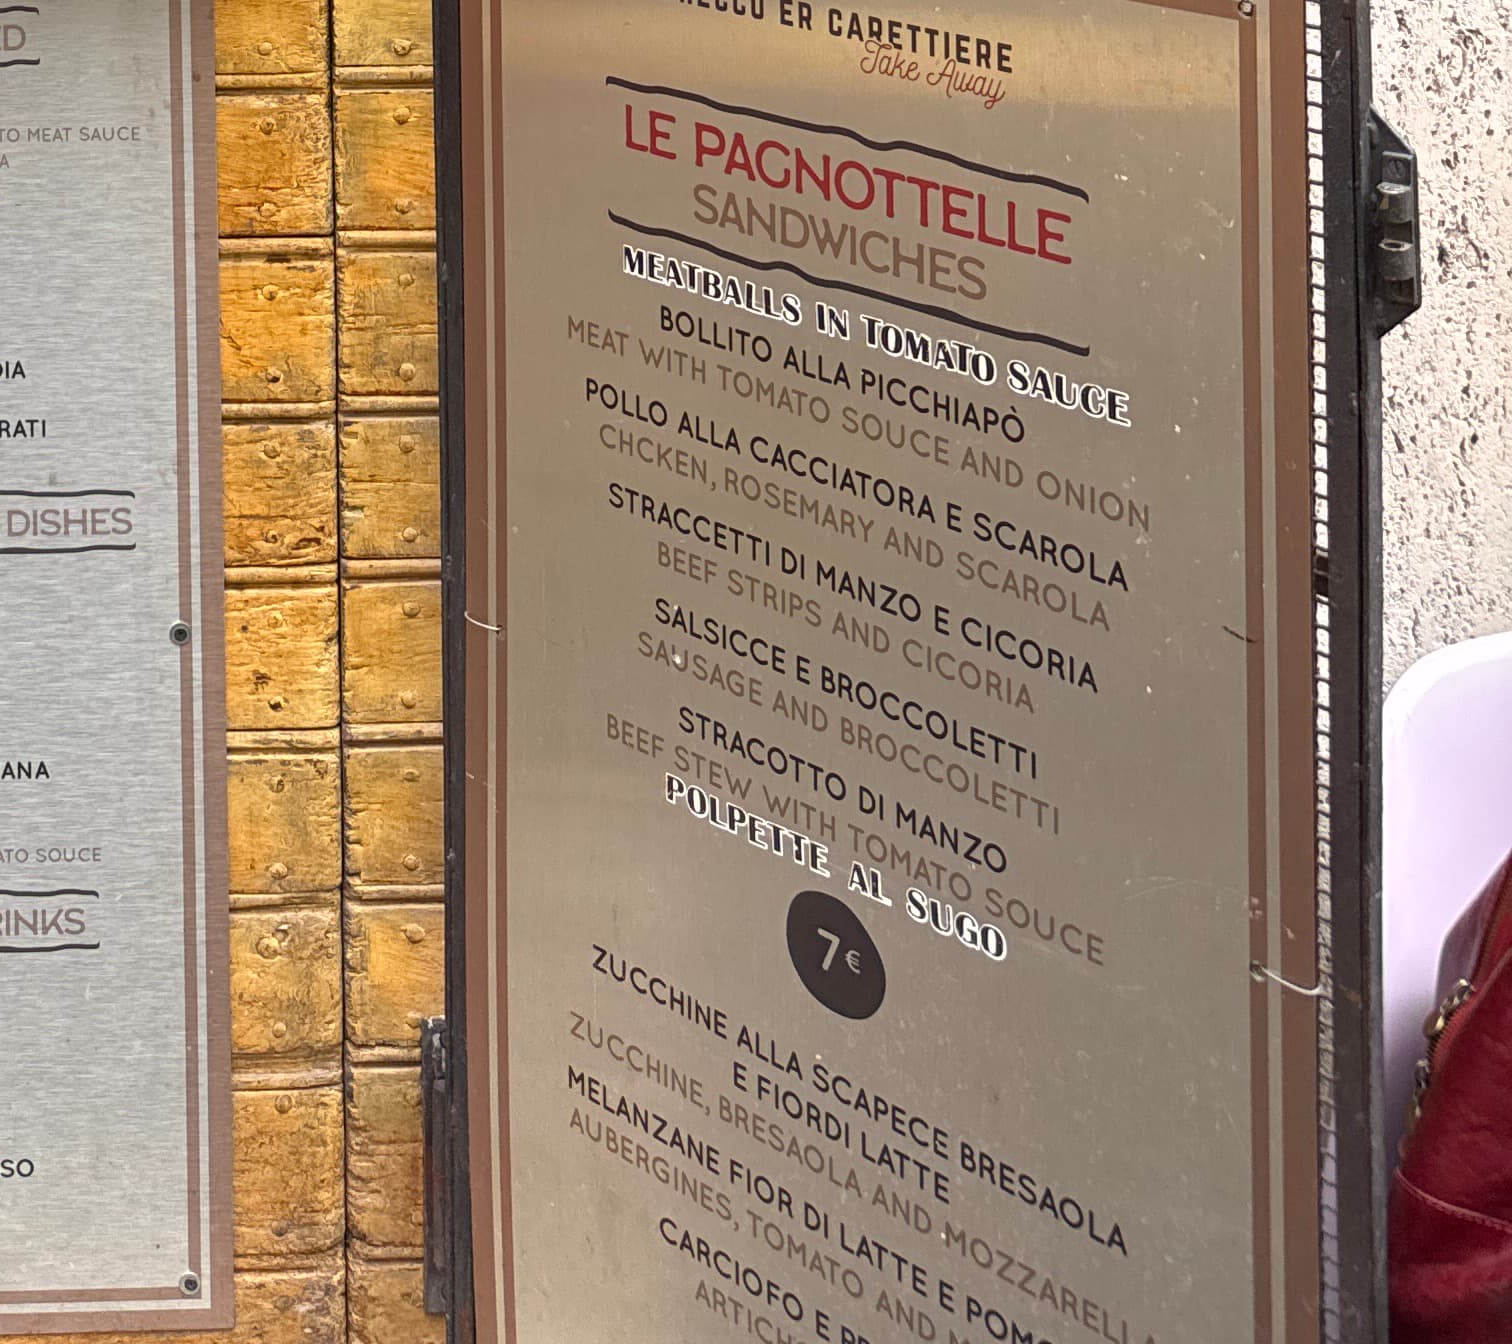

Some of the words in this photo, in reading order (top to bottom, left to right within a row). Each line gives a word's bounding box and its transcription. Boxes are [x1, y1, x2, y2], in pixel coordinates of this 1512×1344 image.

[829, 8, 1012, 74] CARETTIERE
[860, 39, 920, 81] Take
[926, 58, 1006, 110] Away
[28, 127, 72, 143] MEAT
[79, 126, 140, 142] SAUCE
[626, 105, 676, 160] LE
[695, 122, 1072, 264] PAGNOTTELLE
[693, 184, 987, 300] SANDWICHES
[622, 246, 802, 324] MEATBALLS
[816, 302, 849, 340] IN
[863, 313, 997, 384] TOMATO
[1008, 360, 1131, 427] SAUCE
[661, 305, 772, 362] BOLLITO
[783, 346, 850, 391] ALLA
[861, 369, 1025, 443] PICCHIAPÒ
[8, 508, 132, 536] DISHES
[609, 483, 770, 566] STRACCETTI
[781, 547, 805, 579] DI
[817, 562, 921, 623] MANZO
[934, 606, 950, 636] E
[961, 617, 1098, 693] CICORIA
[665, 773, 830, 878] POLPETTE
[847, 861, 892, 907] AL
[905, 887, 1007, 962] SUGO
[593, 944, 727, 1040] ZUCCHINE
[737, 1026, 802, 1079] ALLA
[813, 1064, 948, 1159] SCAPECE
[961, 1142, 1127, 1256] BRESAOLA
[733, 1061, 747, 1092] E
[861, 1132, 949, 1204] LATTE
